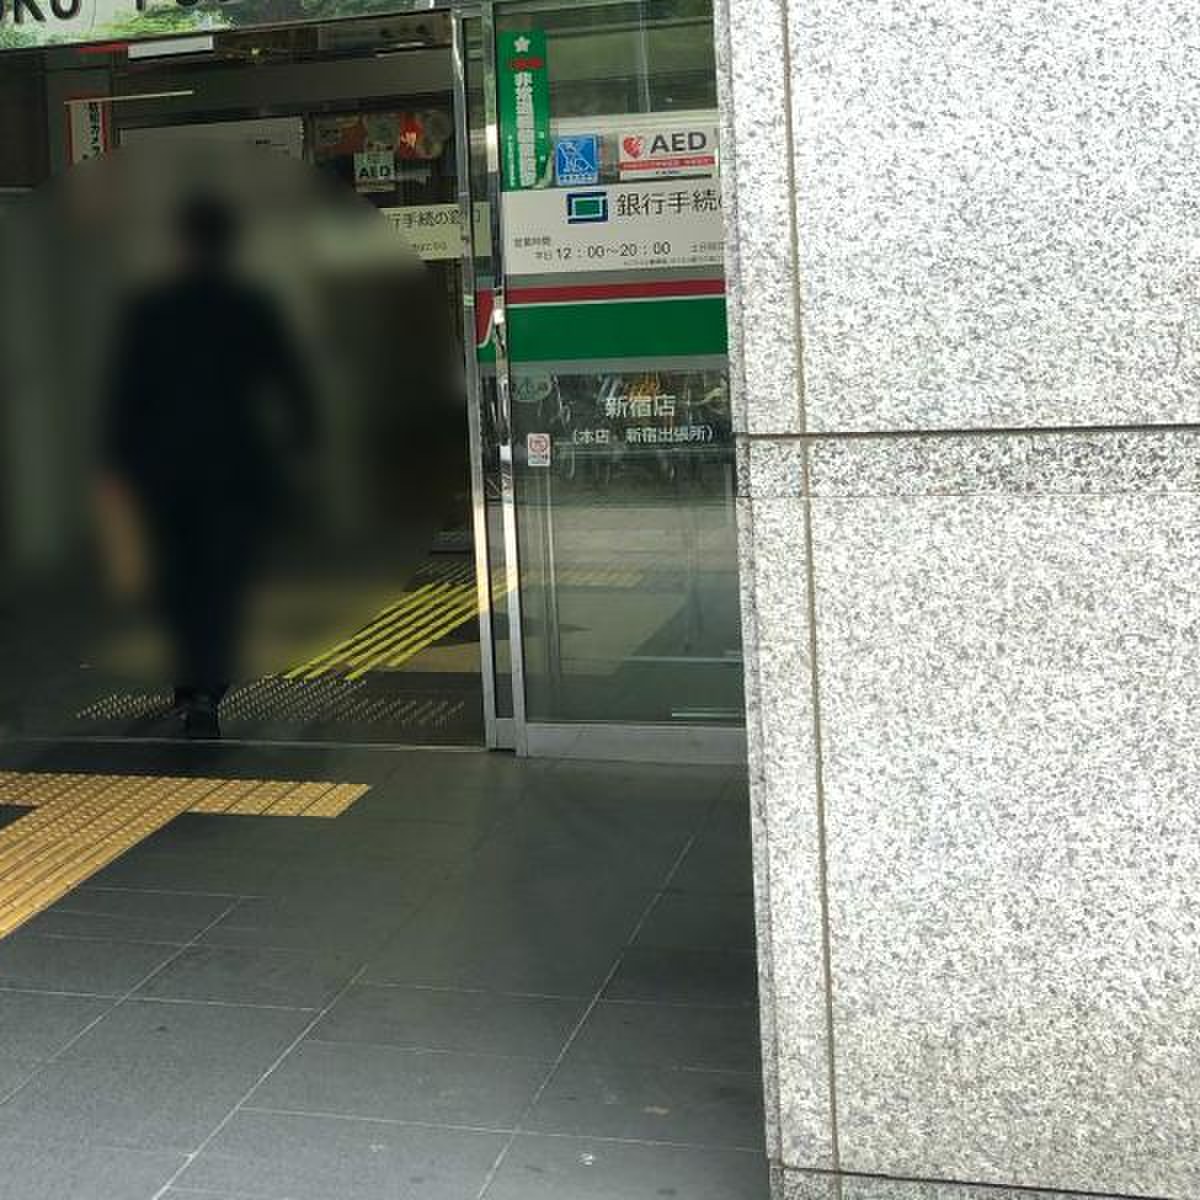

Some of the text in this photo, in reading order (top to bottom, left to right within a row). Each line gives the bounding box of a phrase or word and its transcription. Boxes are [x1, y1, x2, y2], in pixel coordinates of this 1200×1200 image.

[650, 132, 707, 154] AED
[359, 163, 391, 178] AED
[605, 394, 676, 418] 新宿店
